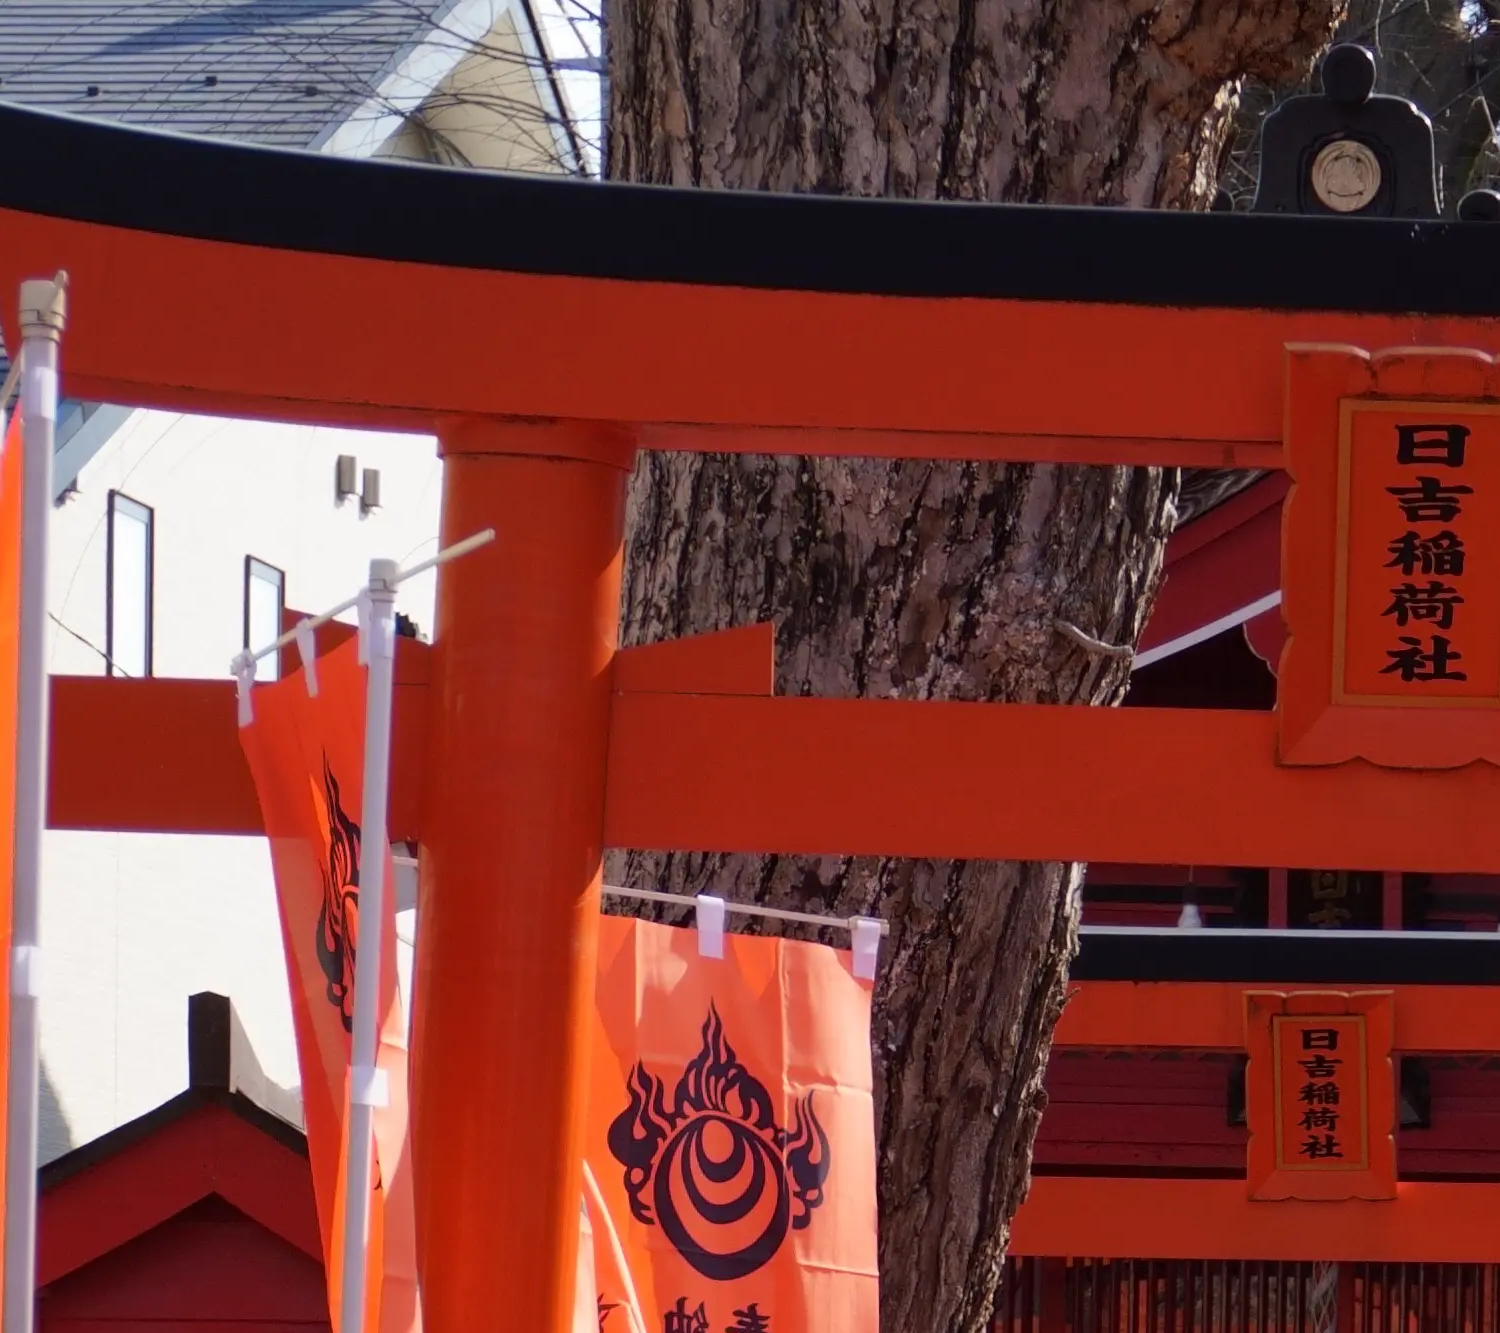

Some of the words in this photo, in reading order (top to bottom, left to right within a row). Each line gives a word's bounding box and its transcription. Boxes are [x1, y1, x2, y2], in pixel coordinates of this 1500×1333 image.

[1380, 423, 1474, 682] 日吉稲荷社
[1298, 1028, 1344, 1159] 日吉稲荷社
